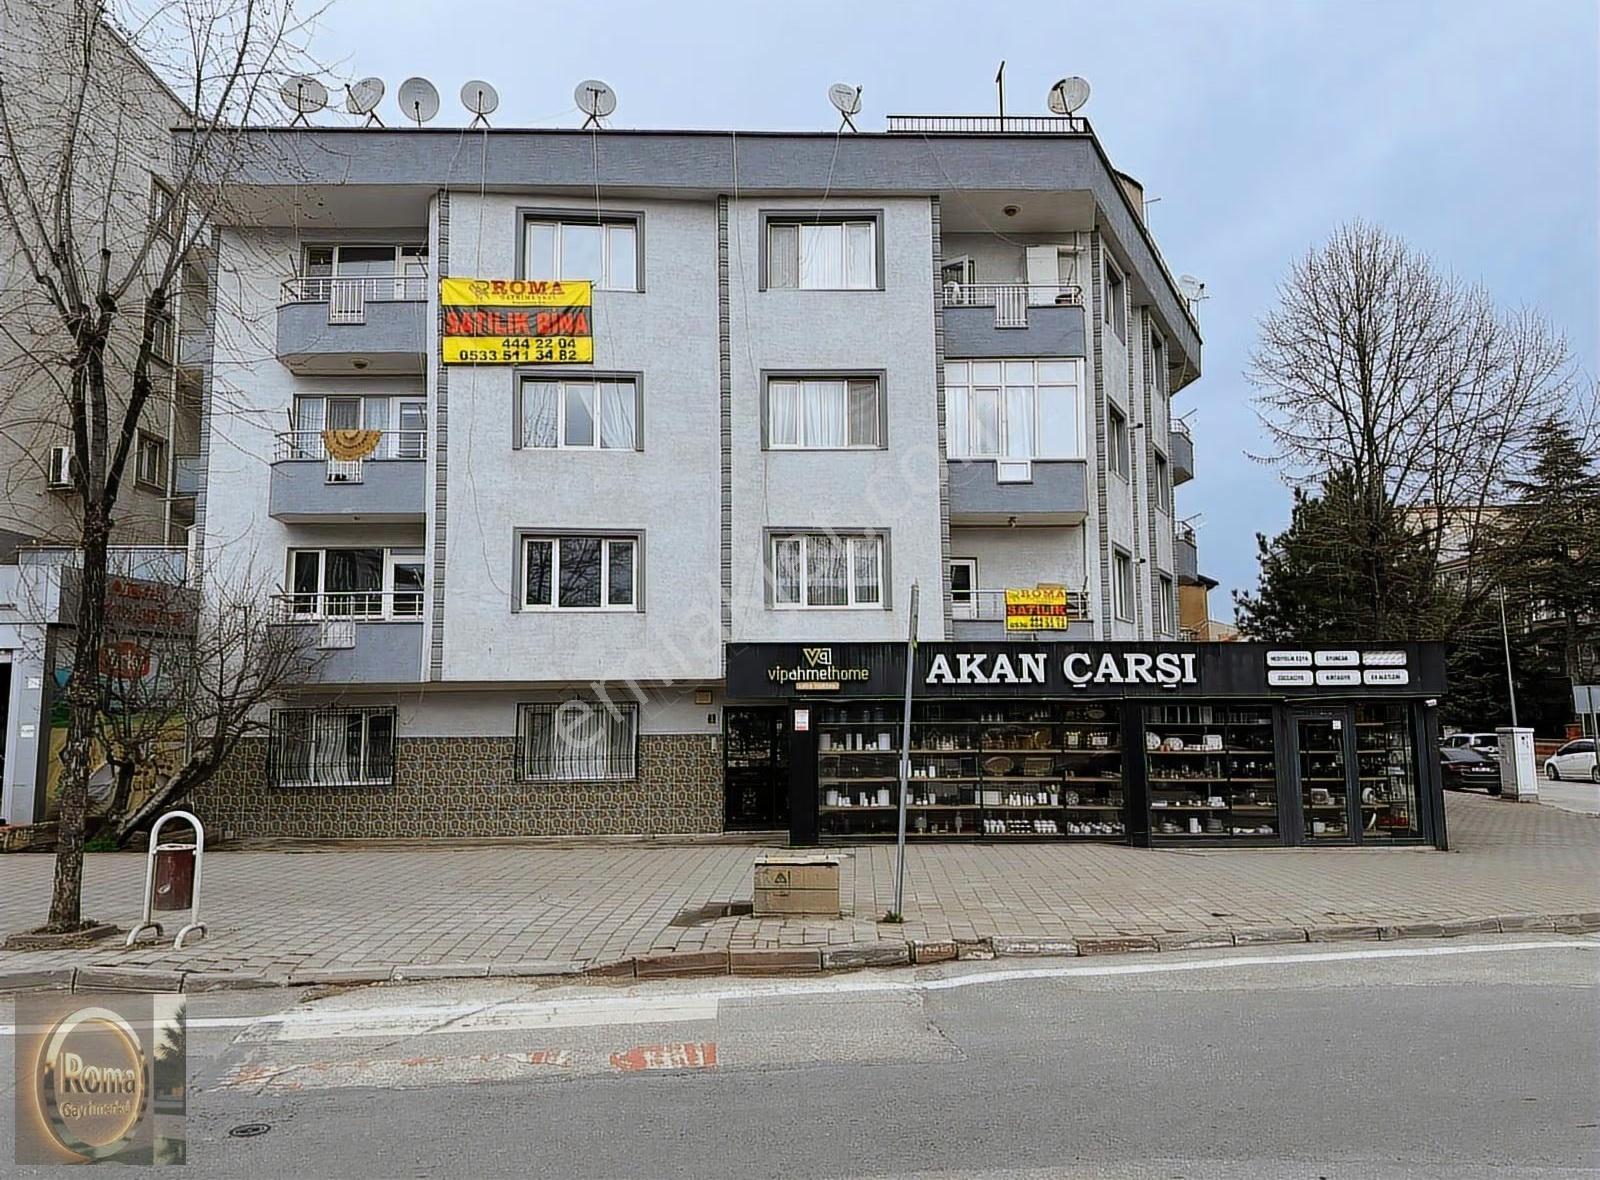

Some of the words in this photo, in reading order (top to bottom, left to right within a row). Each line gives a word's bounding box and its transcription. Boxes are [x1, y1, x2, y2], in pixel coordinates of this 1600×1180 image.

[491, 280, 565, 295] ROMA
[446, 311, 530, 335] SATILIK
[502, 338, 529, 348] 444
[535, 338, 552, 348] 22
[558, 338, 576, 348] 04
[459, 350, 497, 360] 0533
[535, 350, 552, 360] 34
[559, 350, 577, 360] 82
[1020, 588, 1065, 598] ROMA
[1007, 605, 1066, 615] SATILIK
[926, 653, 1047, 683] AKAN
[1063, 652, 1197, 688] ÇARŞI
